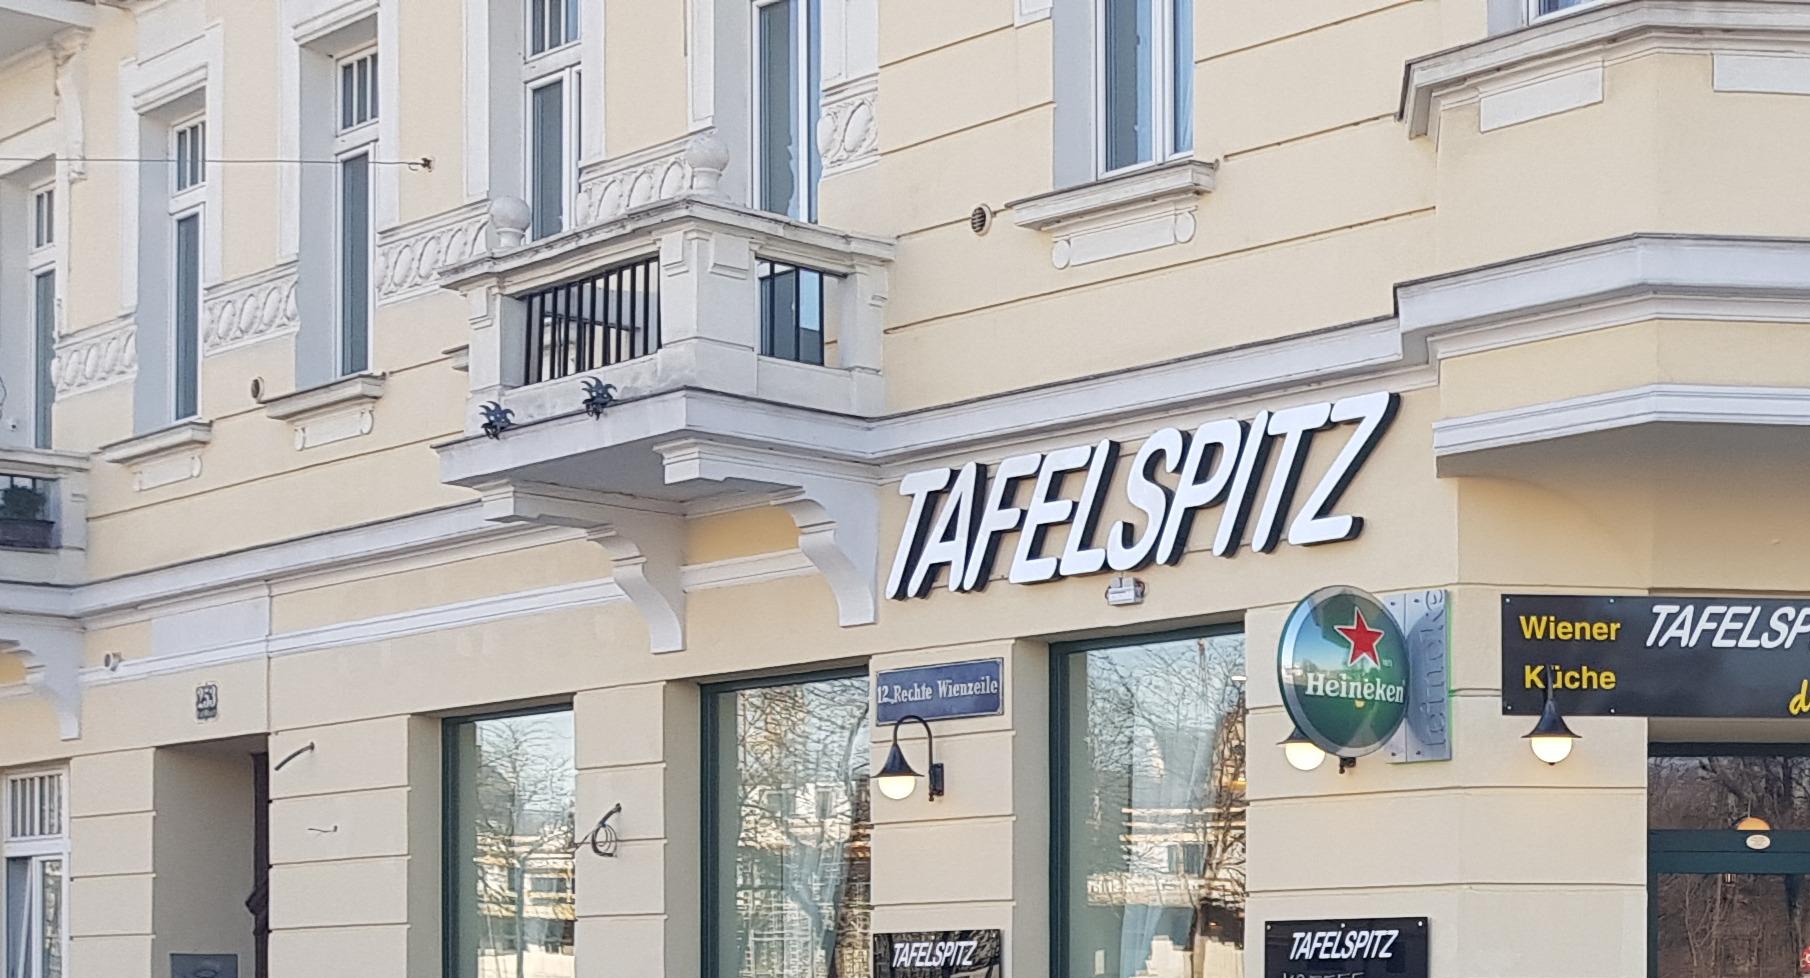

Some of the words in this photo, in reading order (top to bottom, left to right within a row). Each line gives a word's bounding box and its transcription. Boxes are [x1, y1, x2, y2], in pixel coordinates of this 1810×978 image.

[886, 390, 1400, 600] TAFELSPITZ
[1518, 614, 1622, 641] Wiener
[893, 682, 934, 703] Rechte
[937, 675, 999, 699] Wienzeile
[1305, 671, 1406, 704] Heineken
[1524, 664, 1617, 690] Küche
[892, 940, 978, 968] TAFELSPITZ
[1289, 929, 1399, 961] TAFELSPITZ
